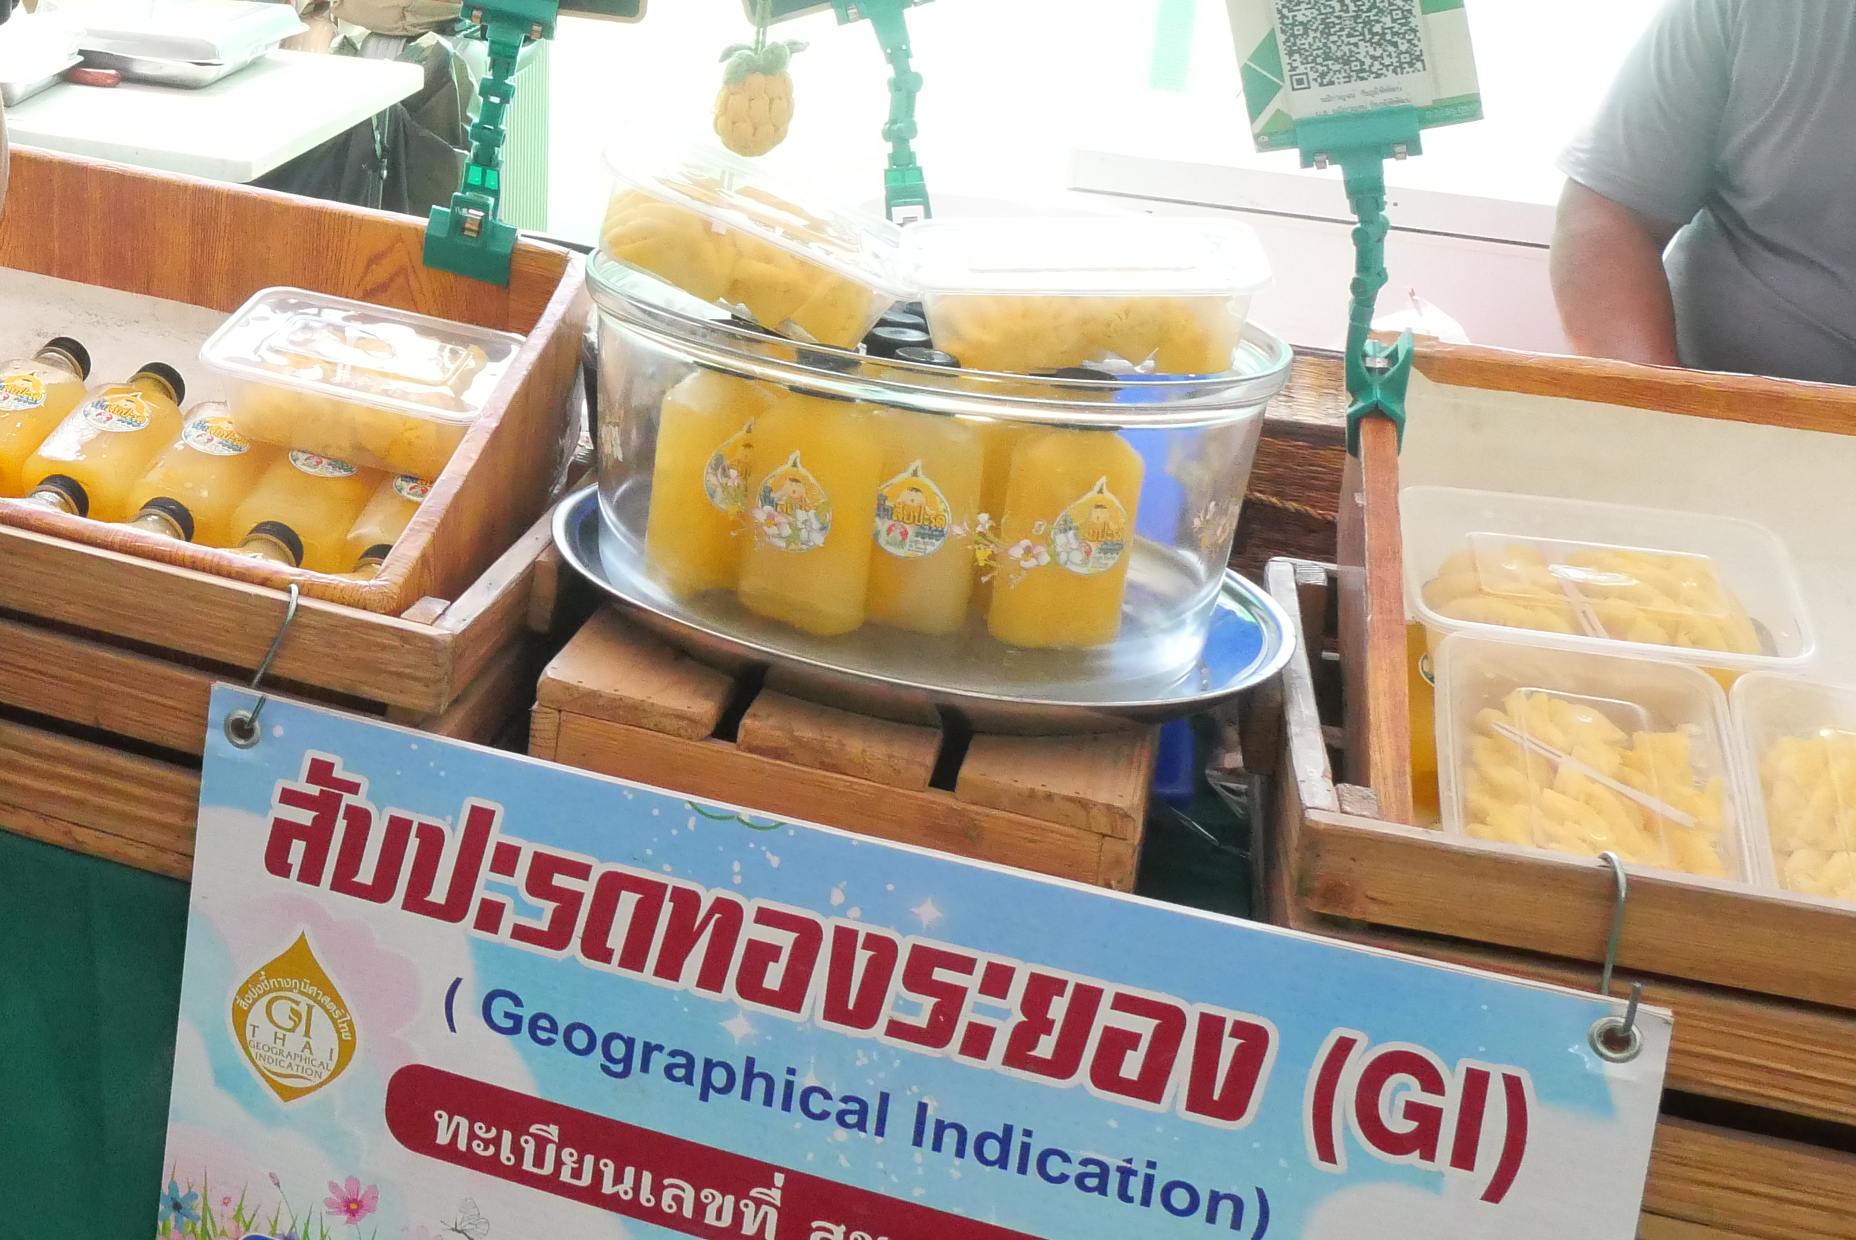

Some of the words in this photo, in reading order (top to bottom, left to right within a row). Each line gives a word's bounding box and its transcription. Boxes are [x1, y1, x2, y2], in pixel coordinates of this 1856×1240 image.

[263, 756, 1272, 1122] สับปะรดทองระยอง
[1311, 1035, 1530, 1204] (GI)
[248, 1039, 332, 1073] GEOGRAPHICAL
[254, 1050, 323, 1080] INDICATION
[482, 988, 889, 1140] Geographical
[912, 1100, 1270, 1240] Indication)
[433, 1109, 786, 1240] ทะเบียนเลขที่
